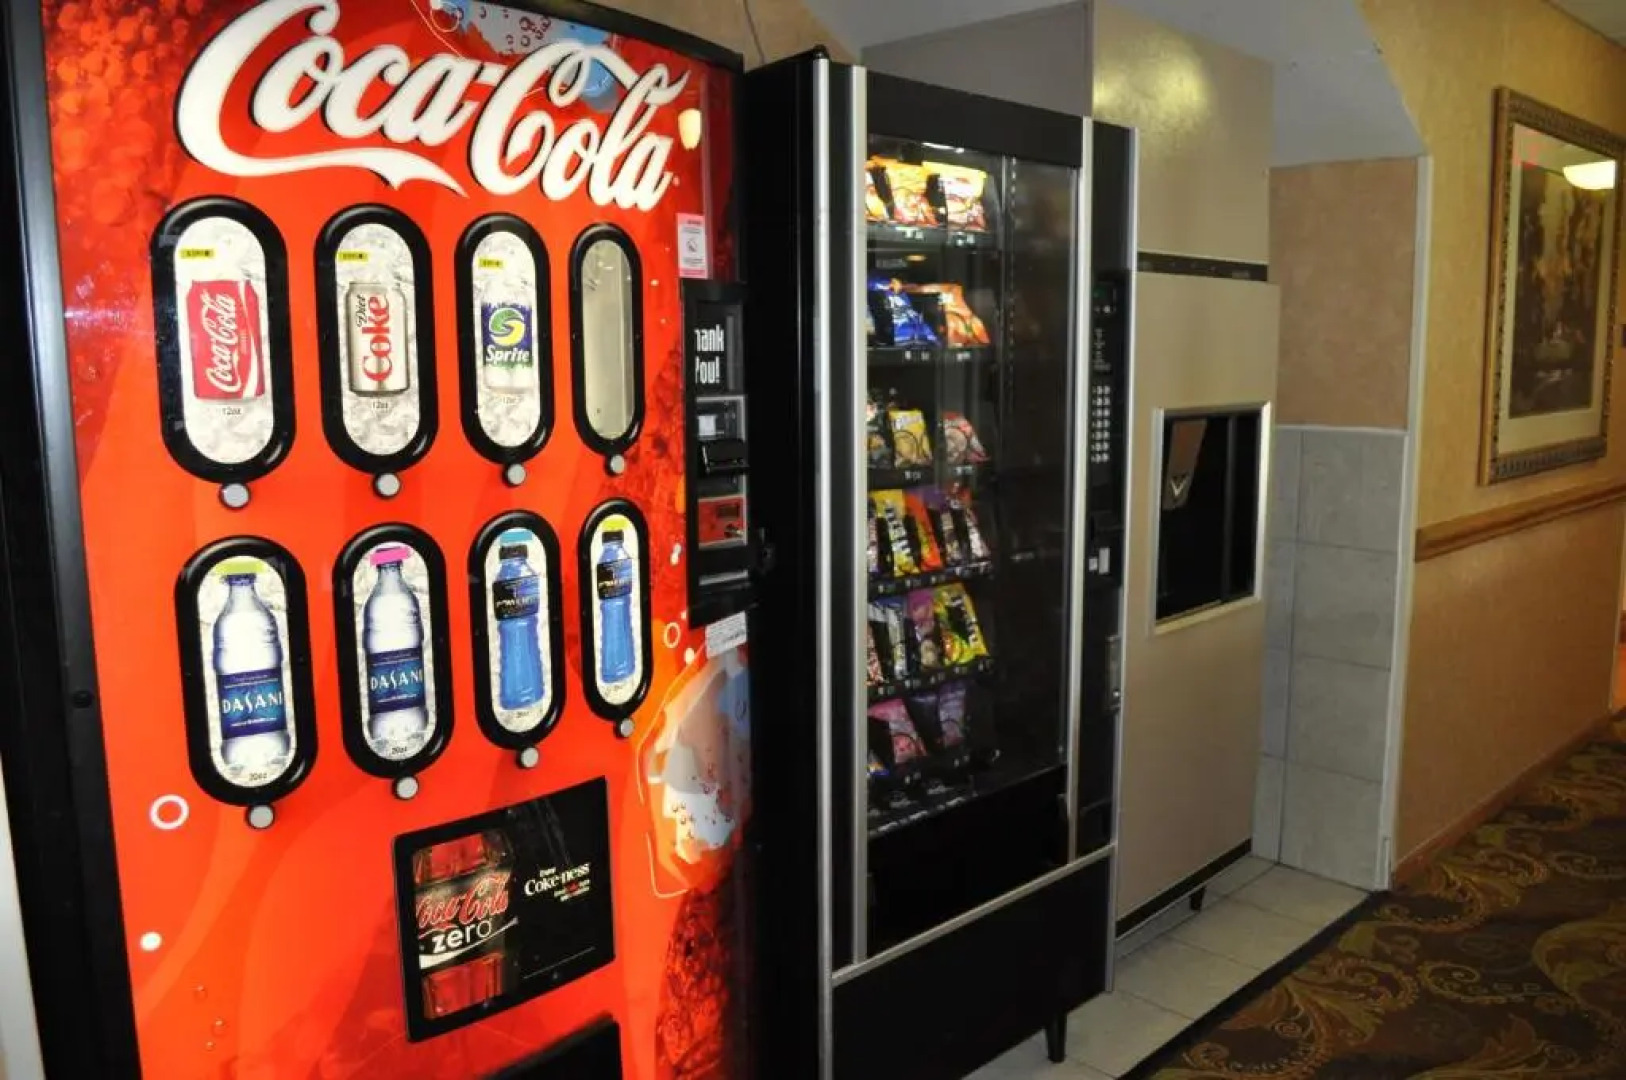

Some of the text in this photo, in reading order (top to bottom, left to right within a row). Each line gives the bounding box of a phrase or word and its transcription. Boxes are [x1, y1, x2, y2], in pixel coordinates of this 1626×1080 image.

[177, 0, 691, 211] Coca-Cola
[357, 294, 366, 328] Diet
[361, 296, 393, 382] Coke
[485, 344, 530, 364] Sprite
[369, 668, 424, 691] DASANI
[222, 691, 284, 714] DASANI
[524, 863, 591, 896] Coke-ness
[432, 920, 492, 953] zero
